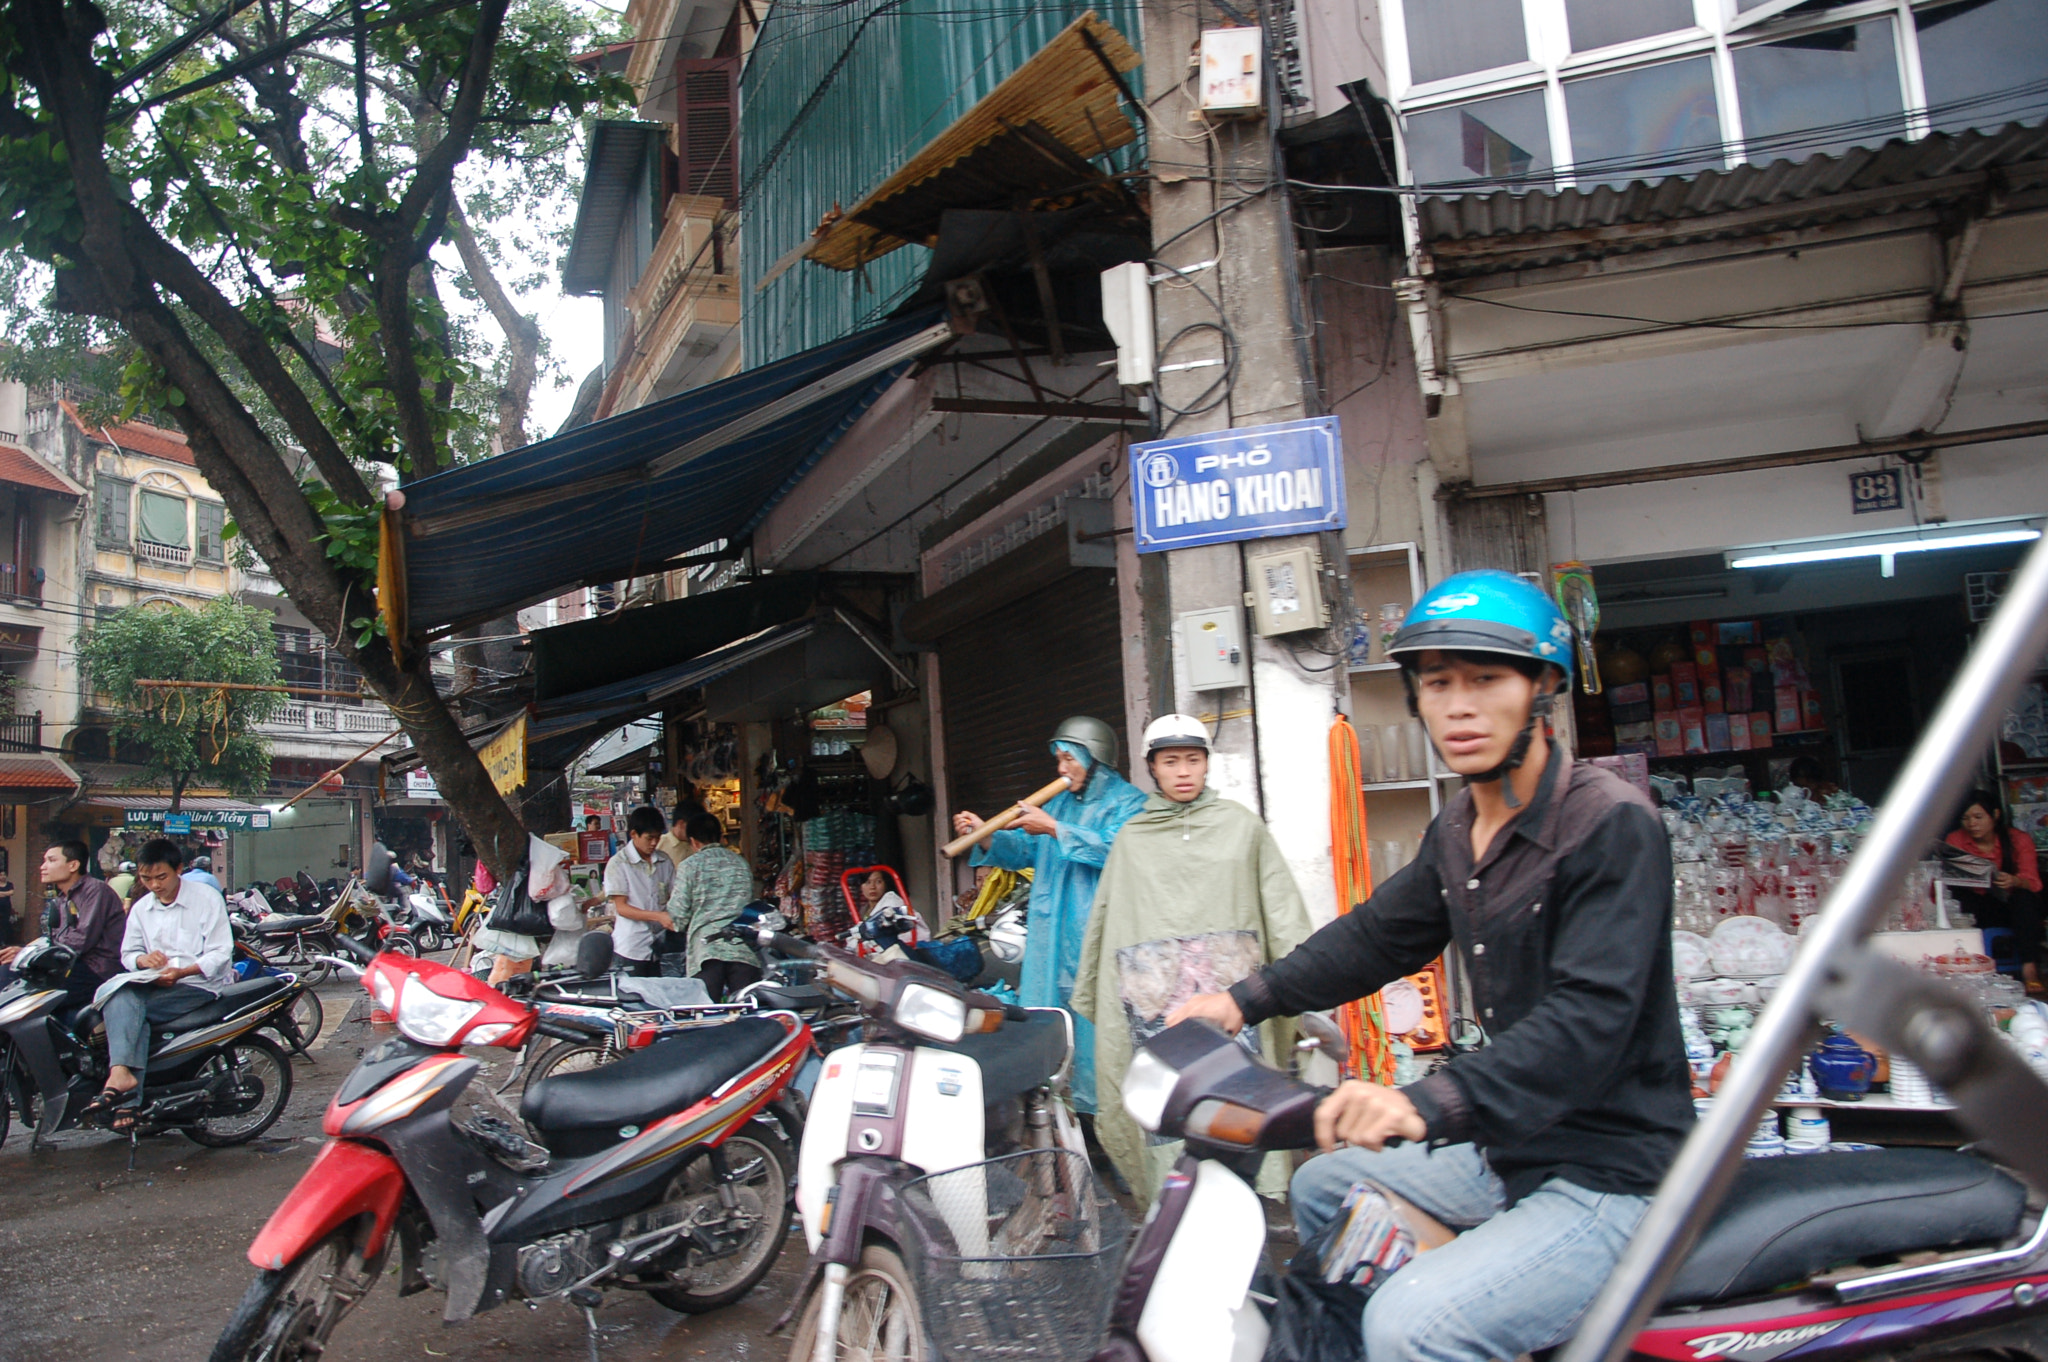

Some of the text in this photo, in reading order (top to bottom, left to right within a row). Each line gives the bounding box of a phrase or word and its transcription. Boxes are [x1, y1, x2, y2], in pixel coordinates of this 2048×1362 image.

[1195, 442, 1273, 473] PHỐ
[1153, 467, 1324, 528] HÀNG KHOAI
[1856, 475, 1896, 499] 83
[1685, 1321, 1842, 1359] Dream
